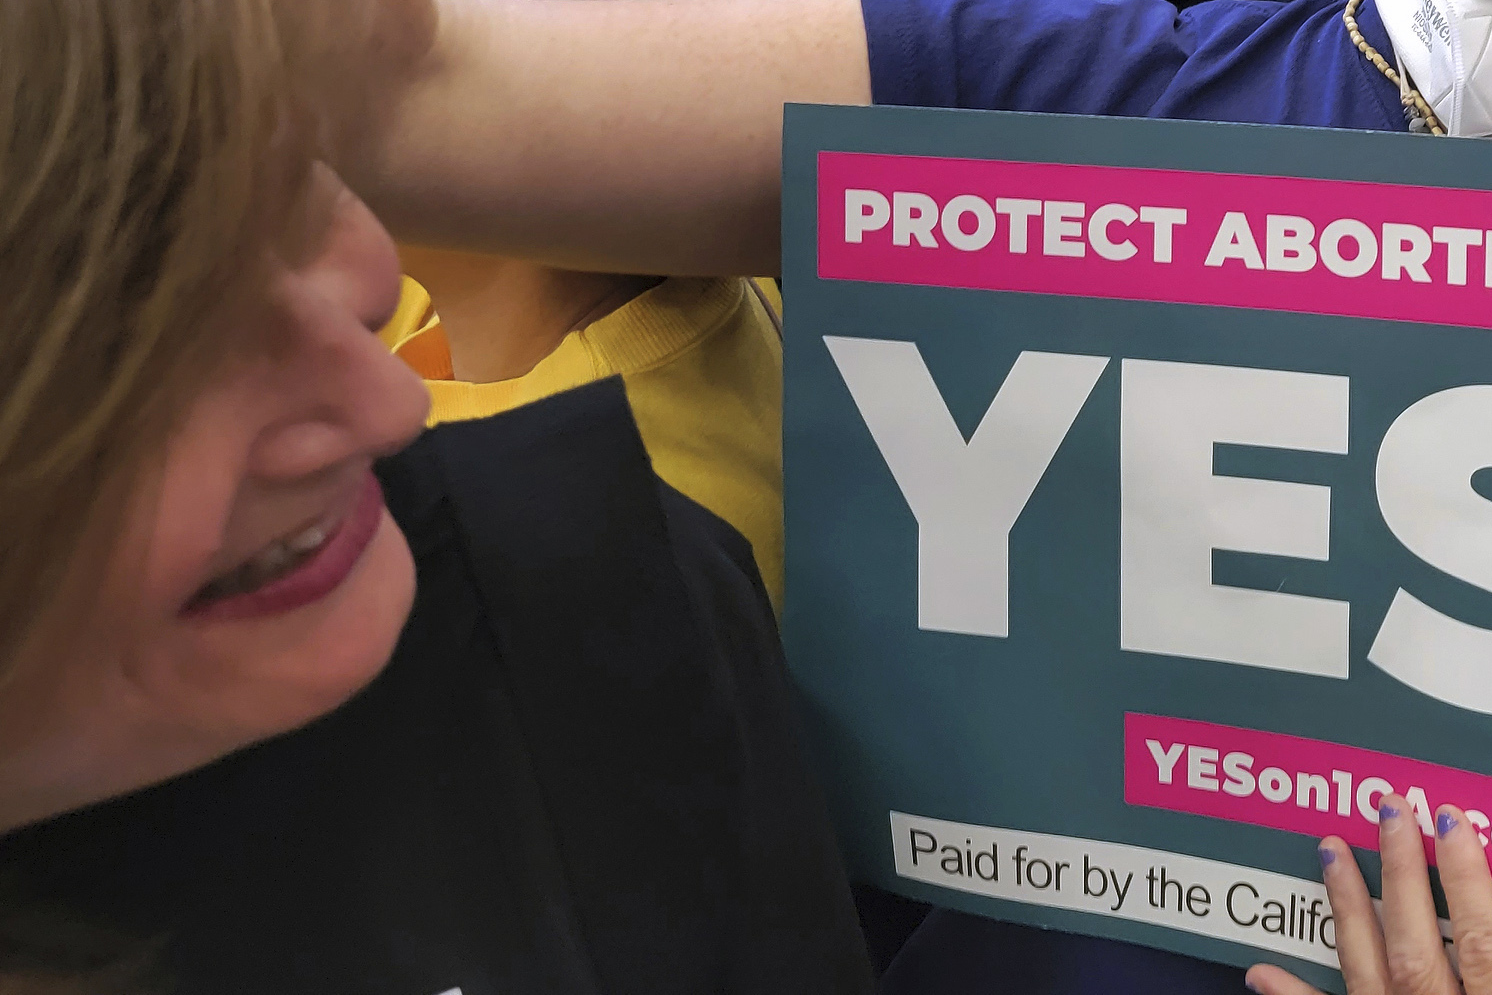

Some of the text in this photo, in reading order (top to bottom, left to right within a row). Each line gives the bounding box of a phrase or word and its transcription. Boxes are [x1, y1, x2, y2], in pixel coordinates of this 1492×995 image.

[843, 188, 1188, 264] PROTECT
[909, 827, 1338, 951] Paid for by the Califo
